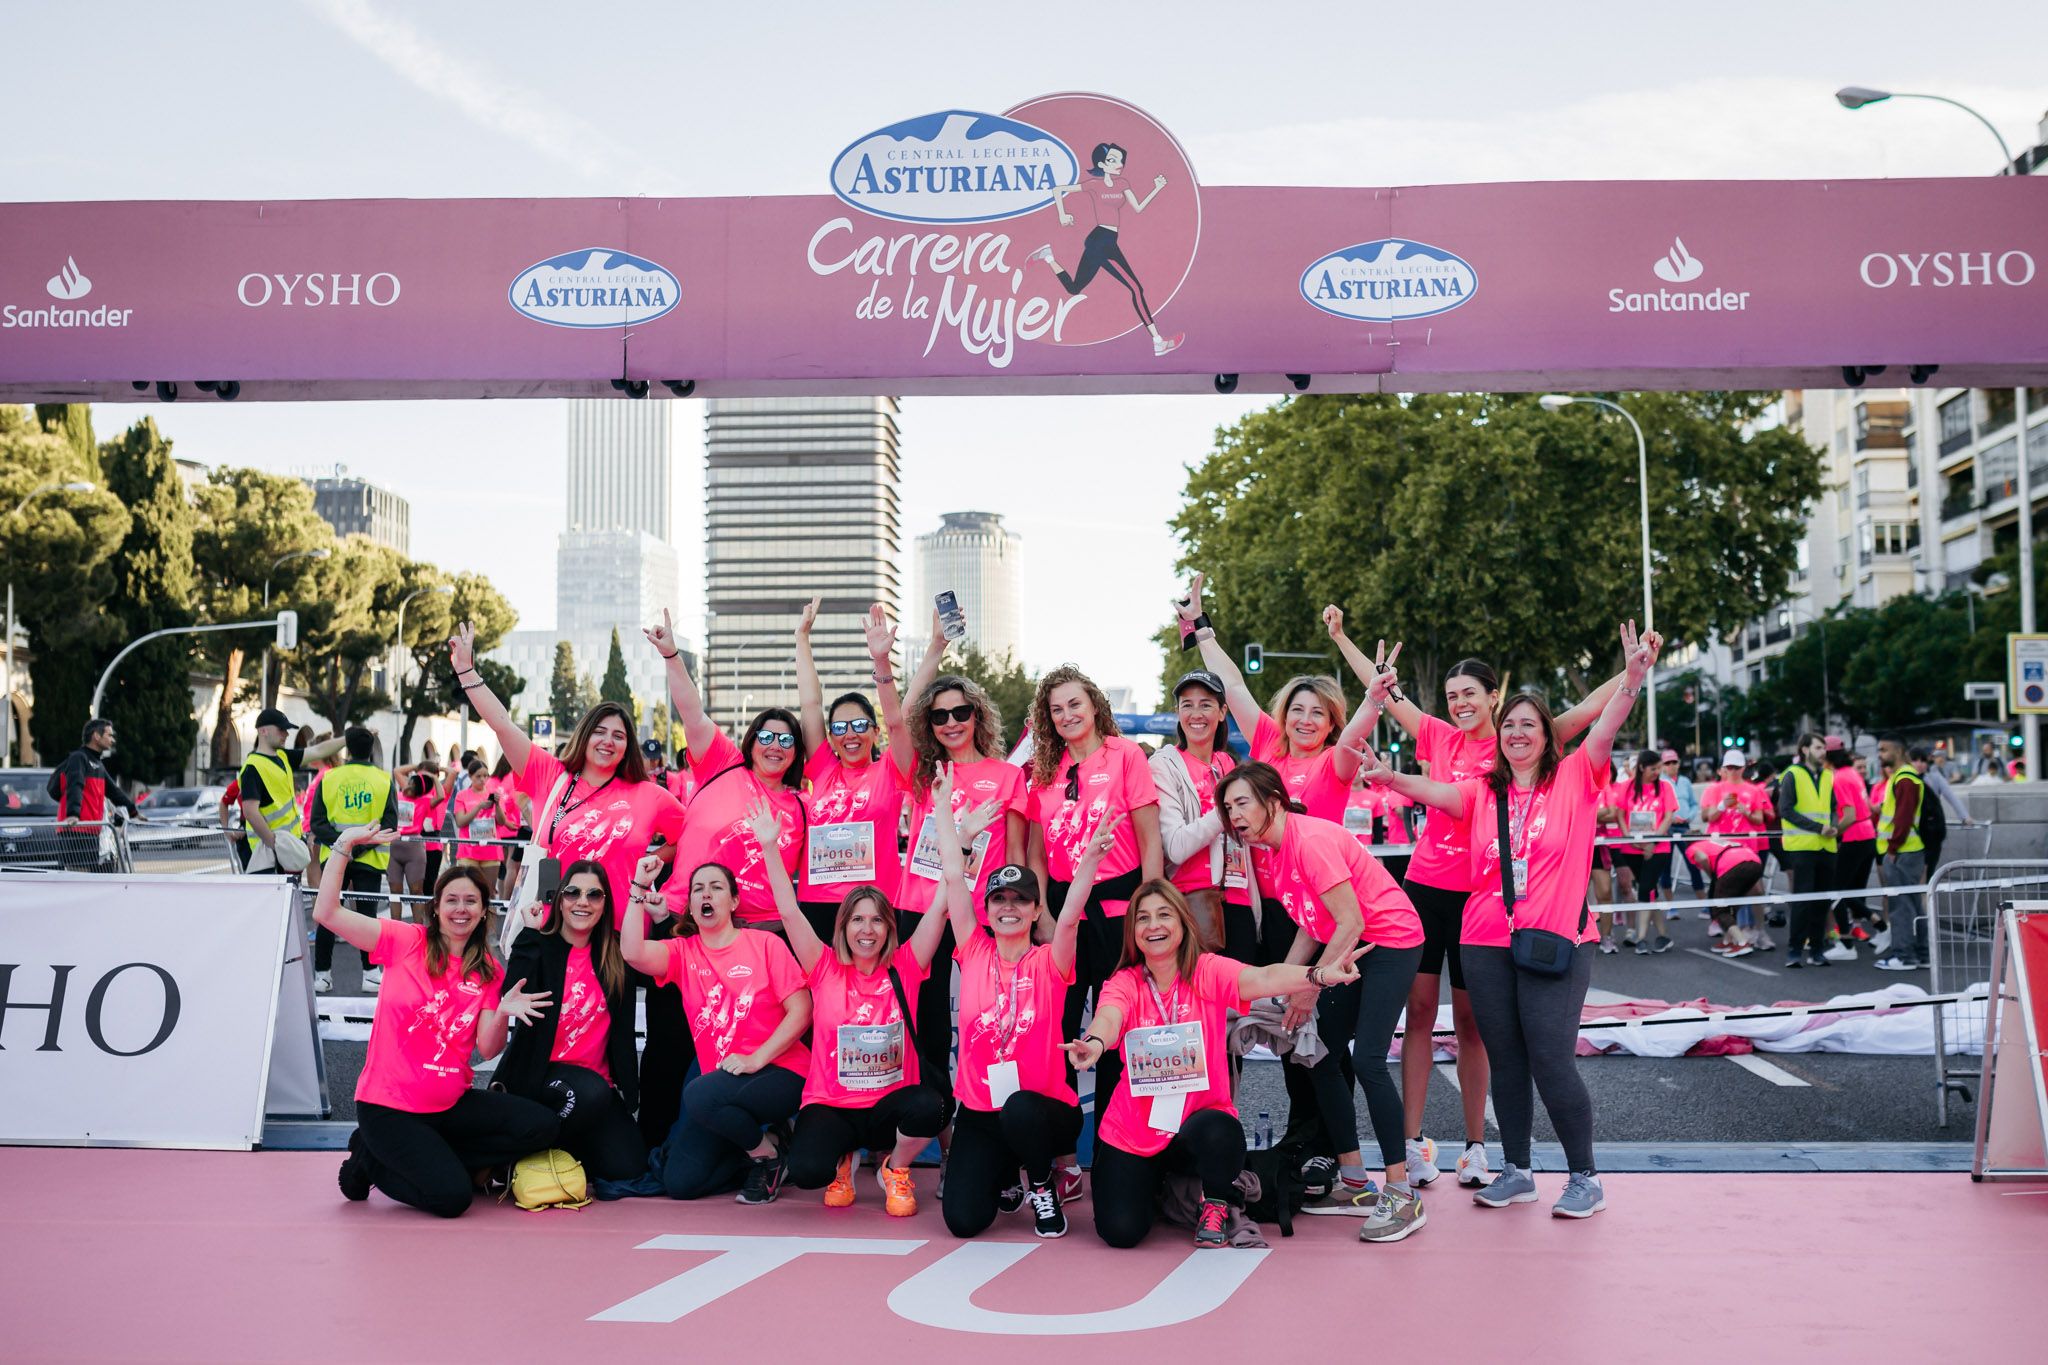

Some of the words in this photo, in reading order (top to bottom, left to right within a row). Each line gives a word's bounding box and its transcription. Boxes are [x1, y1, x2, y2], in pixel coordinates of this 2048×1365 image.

[887, 148, 964, 160] CENTRAL
[973, 146, 1051, 159] LECHERA
[849, 153, 1057, 195] ASTURIANA
[807, 217, 1011, 276] Carrera
[549, 276, 602, 284] CENTRAL
[608, 275, 662, 283] LECHERA
[1340, 267, 1396, 276] CENTRAL
[1401, 265, 1457, 274] LECHERA
[1859, 250, 2036, 288] OYSHO
[237, 273, 401, 307] OYSHO
[522, 278, 667, 307] ASTURIANA
[1314, 269, 1463, 300] ASTURIANA
[1608, 287, 1750, 312] Santander
[2, 304, 133, 328] Santander
[856, 278, 894, 320] de
[902, 277, 929, 320] la
[923, 268, 1088, 368] Mujer
[539, 720, 547, 734] P
[344, 790, 372, 810] Life
[829, 849, 853, 859] 016
[862, 1052, 888, 1064] 016
[1153, 1055, 1181, 1068] 016
[560, 1090, 576, 1118] OYSHO
[585, 1234, 1273, 1335] TU
